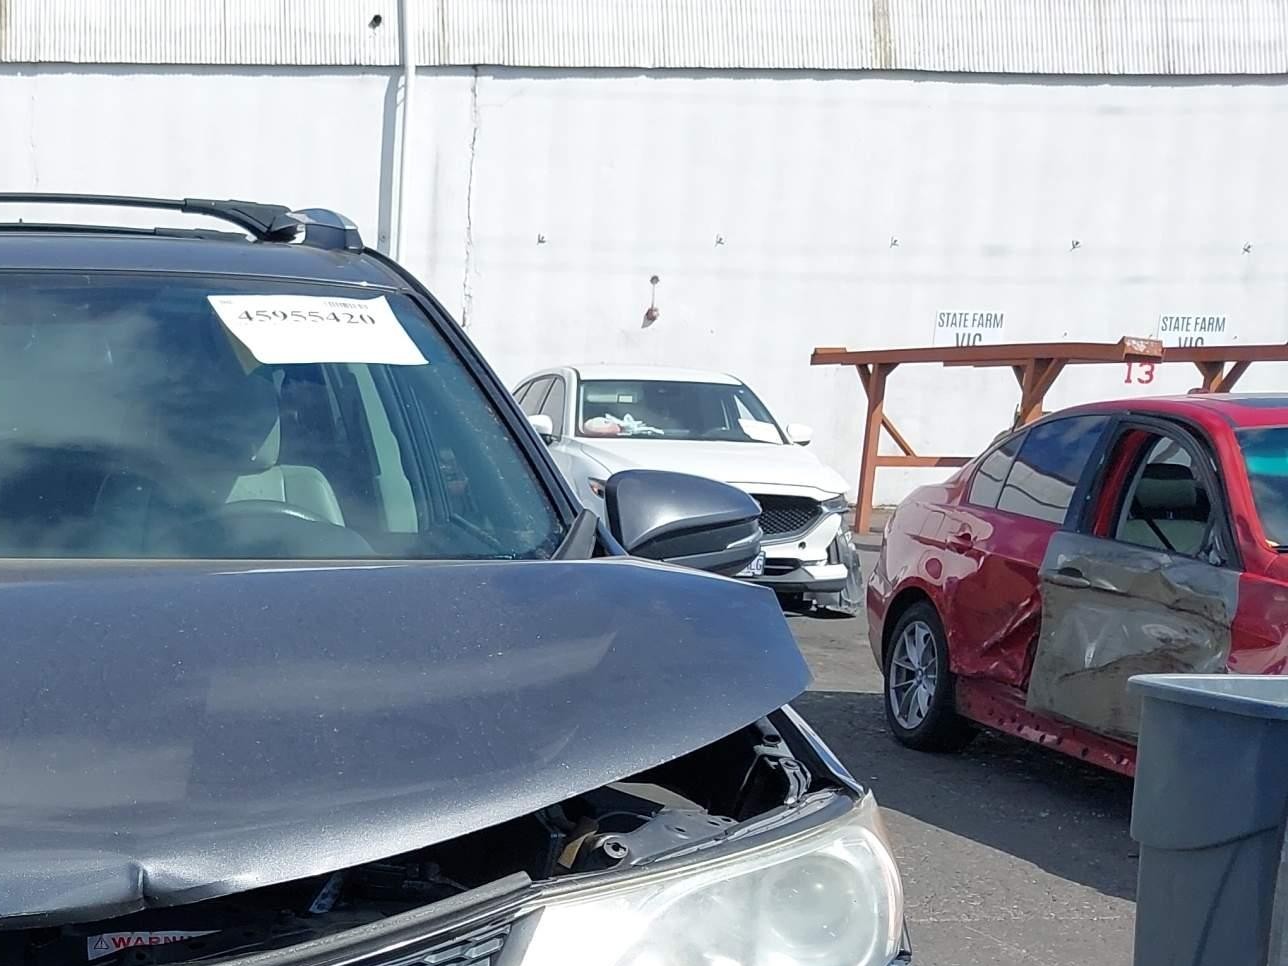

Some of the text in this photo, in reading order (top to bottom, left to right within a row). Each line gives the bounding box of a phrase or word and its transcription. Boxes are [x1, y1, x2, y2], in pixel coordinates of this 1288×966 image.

[238, 310, 376, 326] 45955420
[938, 312, 1004, 328] STATE FARM
[1161, 316, 1226, 332] STATE FARM
[1124, 360, 1156, 384] 13
